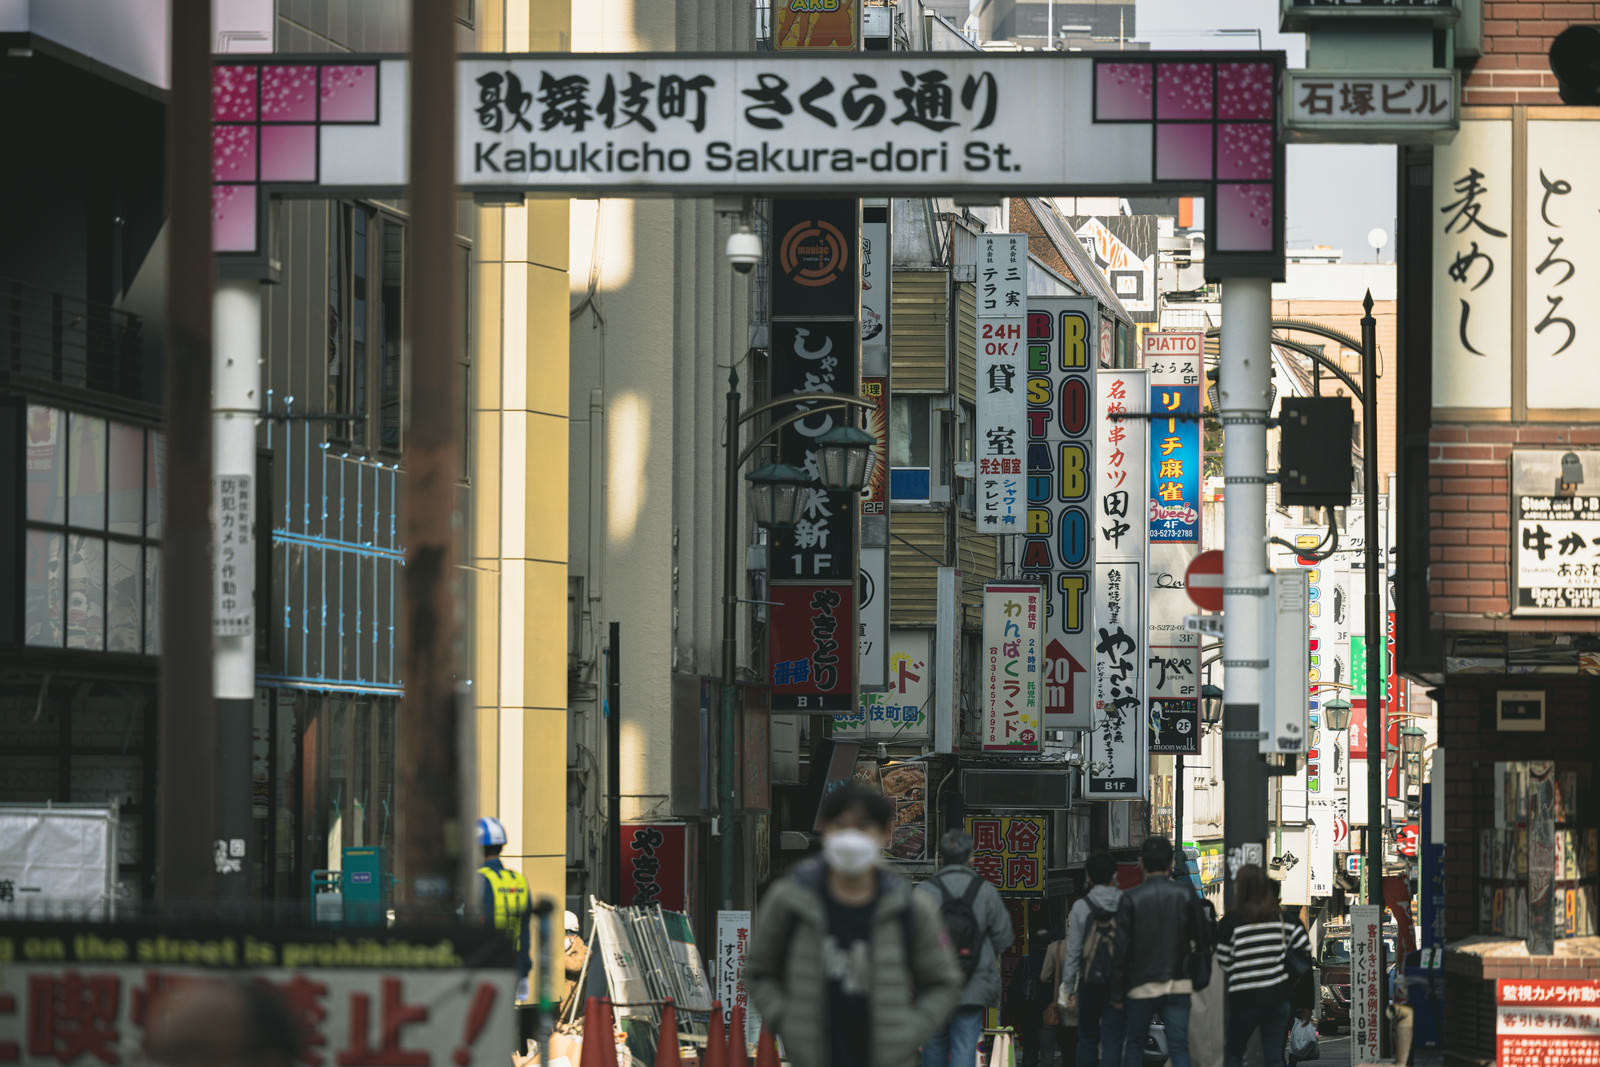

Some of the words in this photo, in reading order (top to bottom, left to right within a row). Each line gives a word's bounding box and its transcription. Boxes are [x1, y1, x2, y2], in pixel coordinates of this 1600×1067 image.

[475, 70, 715, 132] 歌舞伎町
[741, 70, 999, 132] さくら通り
[1300, 80, 1449, 116] 石塚ビル
[475, 142, 690, 173] Kabukicho
[706, 141, 948, 173] Sakura-dori
[964, 142, 1022, 173] St.
[1441, 168, 1508, 357] 麦めし
[1534, 168, 1576, 357] とろろ
[983, 267, 998, 309] テラコ
[982, 323, 1021, 339] 24H
[1147, 337, 1197, 351] PIATTO
[984, 342, 1018, 356] OK!
[1152, 361, 1195, 374] おうみ
[1183, 375, 1198, 384] 5F
[1159, 391, 1185, 502] リーチ麻雀
[980, 458, 1022, 475] 完全個室
[1020, 309, 1056, 631] RESTAURA
[1058, 309, 1091, 636] ROBOT
[863, 501, 885, 514] 2F
[984, 480, 999, 525] テレビ有
[1002, 479, 1017, 525] シャワー有
[1163, 520, 1180, 529] 4F
[1522, 523, 1600, 561] 牛か
[810, 588, 841, 692] やきとり
[1179, 633, 1194, 643] 3F
[1002, 599, 1022, 738] わんぱくランド
[1180, 686, 1195, 694] 2F
[1022, 731, 1034, 741] 2F
[1178, 723, 1190, 732] 2F
[1104, 782, 1127, 790] B1F
[972, 819, 1040, 853] 風俗
[1503, 984, 1600, 1003] 監視カメラ作動
